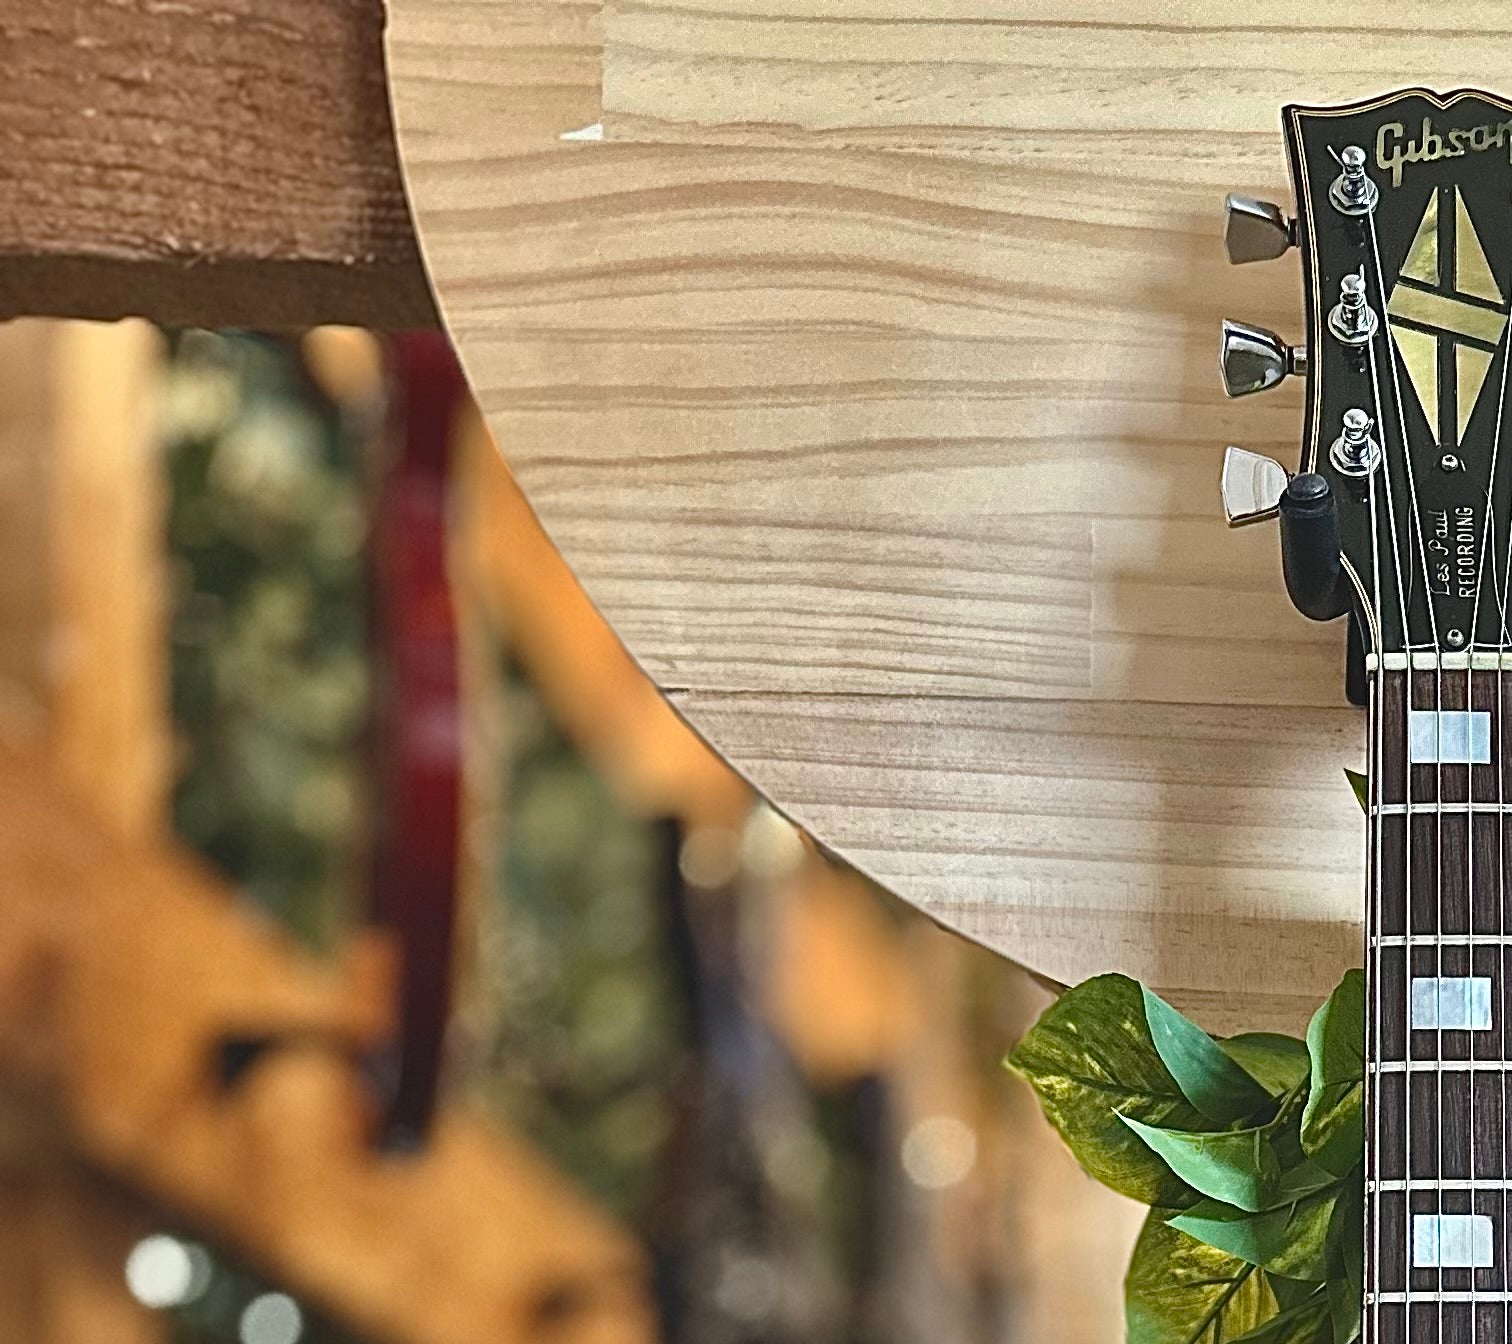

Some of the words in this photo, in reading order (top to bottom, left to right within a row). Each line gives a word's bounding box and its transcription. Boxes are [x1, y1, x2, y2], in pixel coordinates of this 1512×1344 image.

[1427, 509, 1449, 556] Paul
[1454, 506, 1476, 598] RECORDING
[1429, 562, 1450, 596] Les
